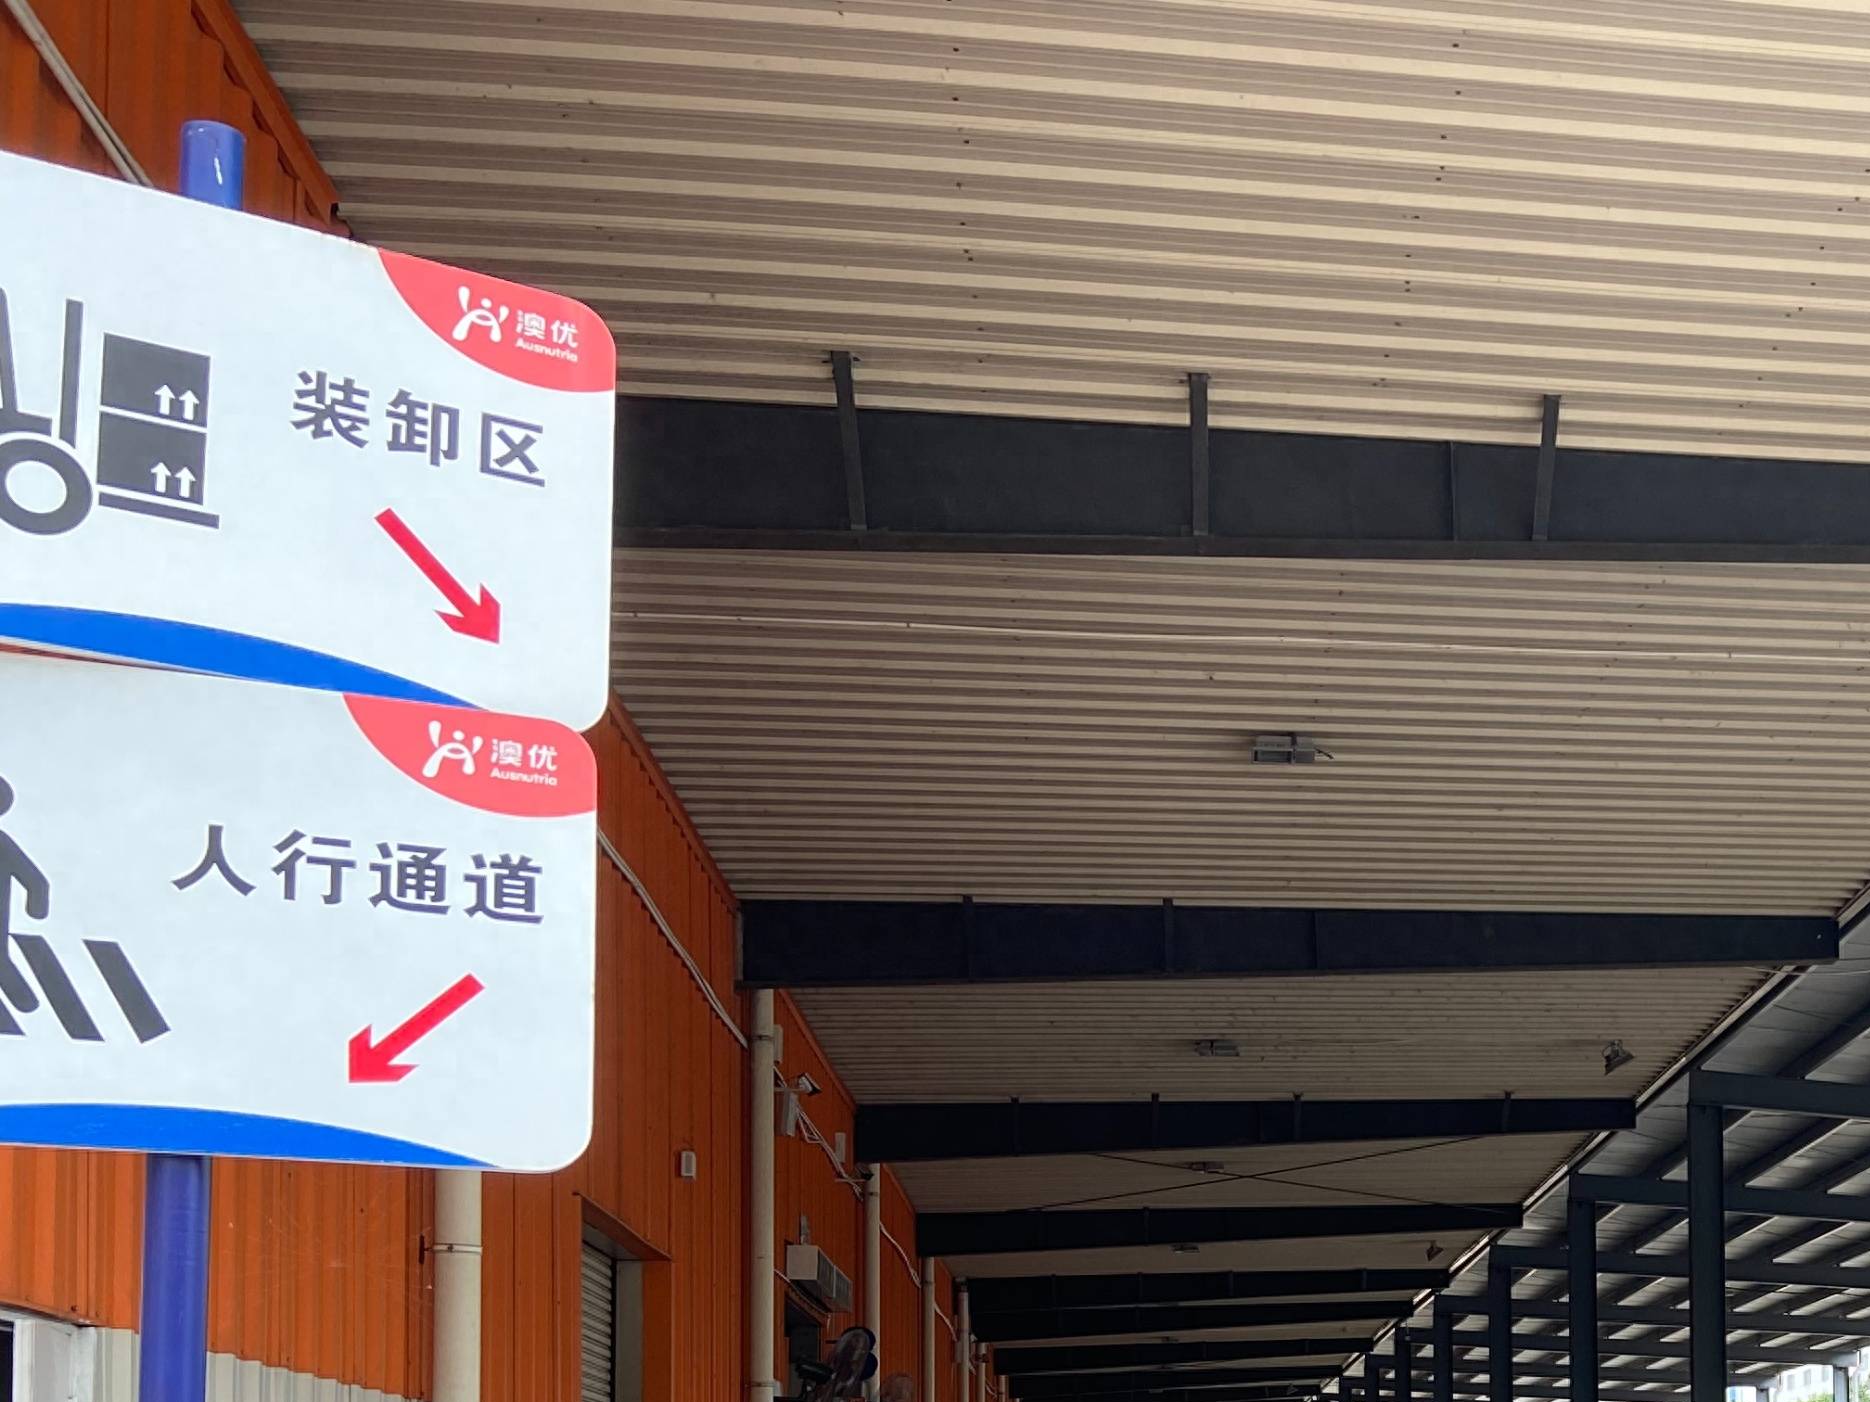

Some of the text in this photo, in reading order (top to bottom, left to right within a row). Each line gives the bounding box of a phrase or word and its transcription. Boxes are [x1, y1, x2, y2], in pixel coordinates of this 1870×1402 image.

[515, 310, 579, 349] 澳优
[515, 337, 578, 363] Ausnutria
[290, 370, 546, 488] 装卸区
[490, 738, 558, 772] 澳优
[490, 767, 558, 787] Ausnutria
[171, 824, 545, 924] 人行通道
